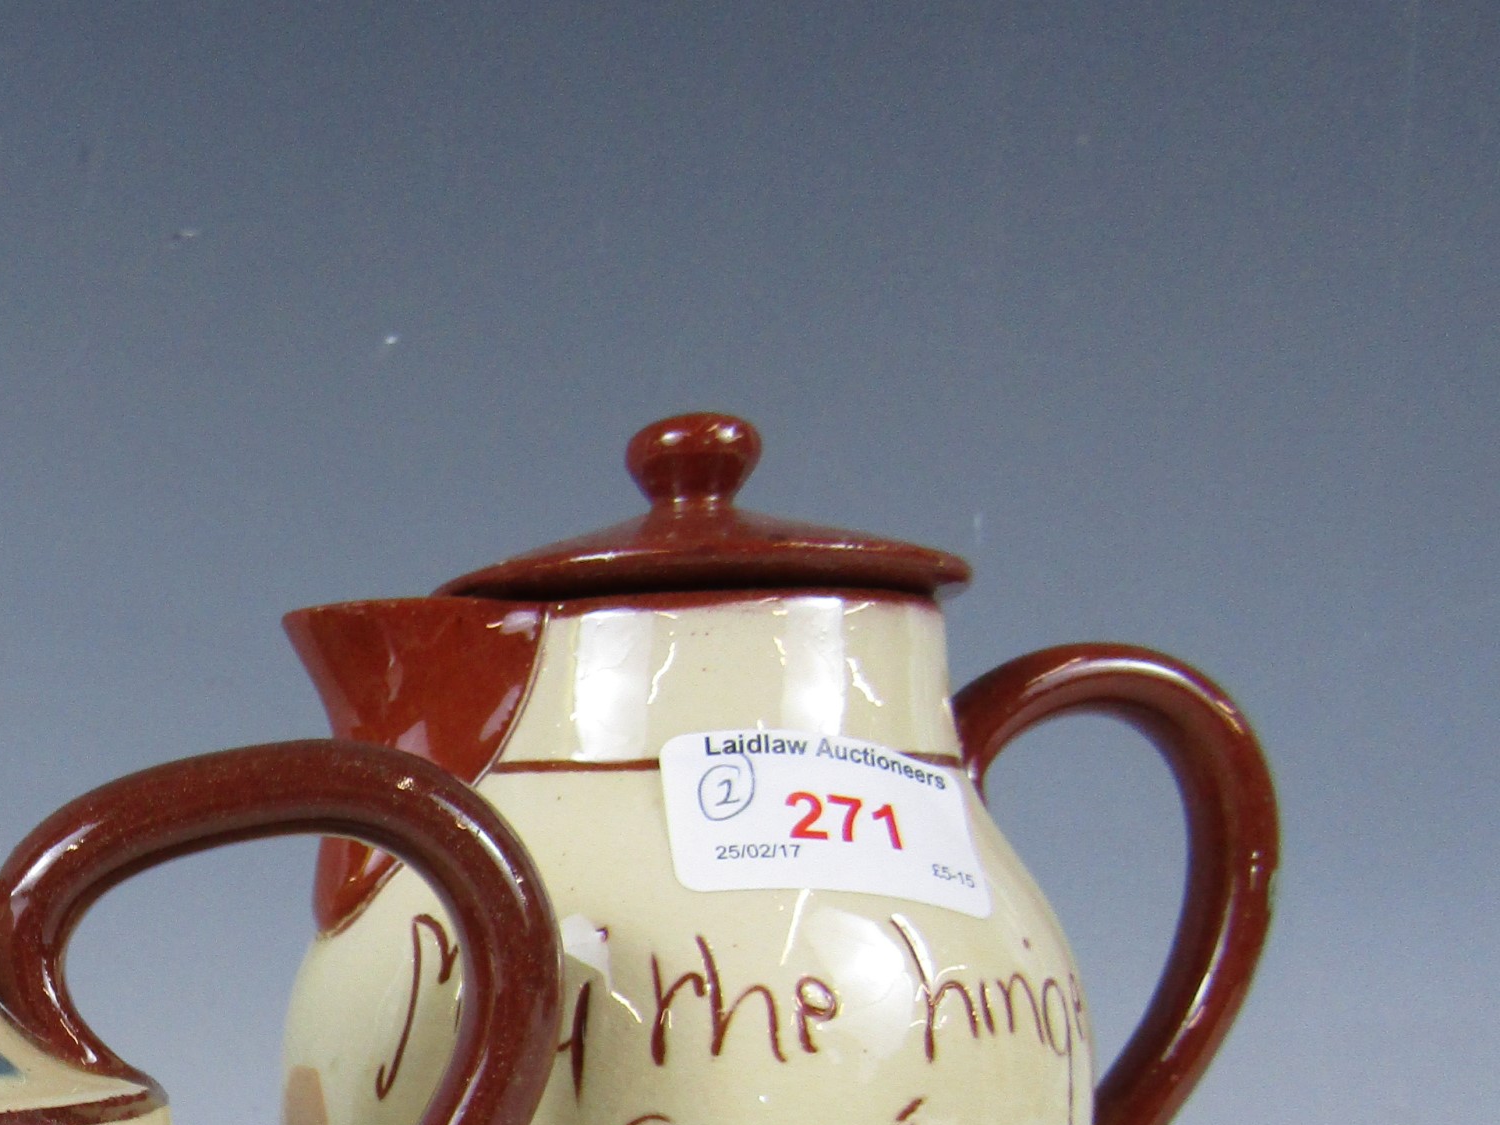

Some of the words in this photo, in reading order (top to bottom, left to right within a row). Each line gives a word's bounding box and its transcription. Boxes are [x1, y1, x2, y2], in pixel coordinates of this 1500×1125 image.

[705, 734, 807, 757] Laidlaw
[816, 738, 946, 790] Auctioneers
[785, 791, 903, 850] 271
[716, 844, 801, 860] 25/02/17
[932, 863, 976, 889] £5-15
